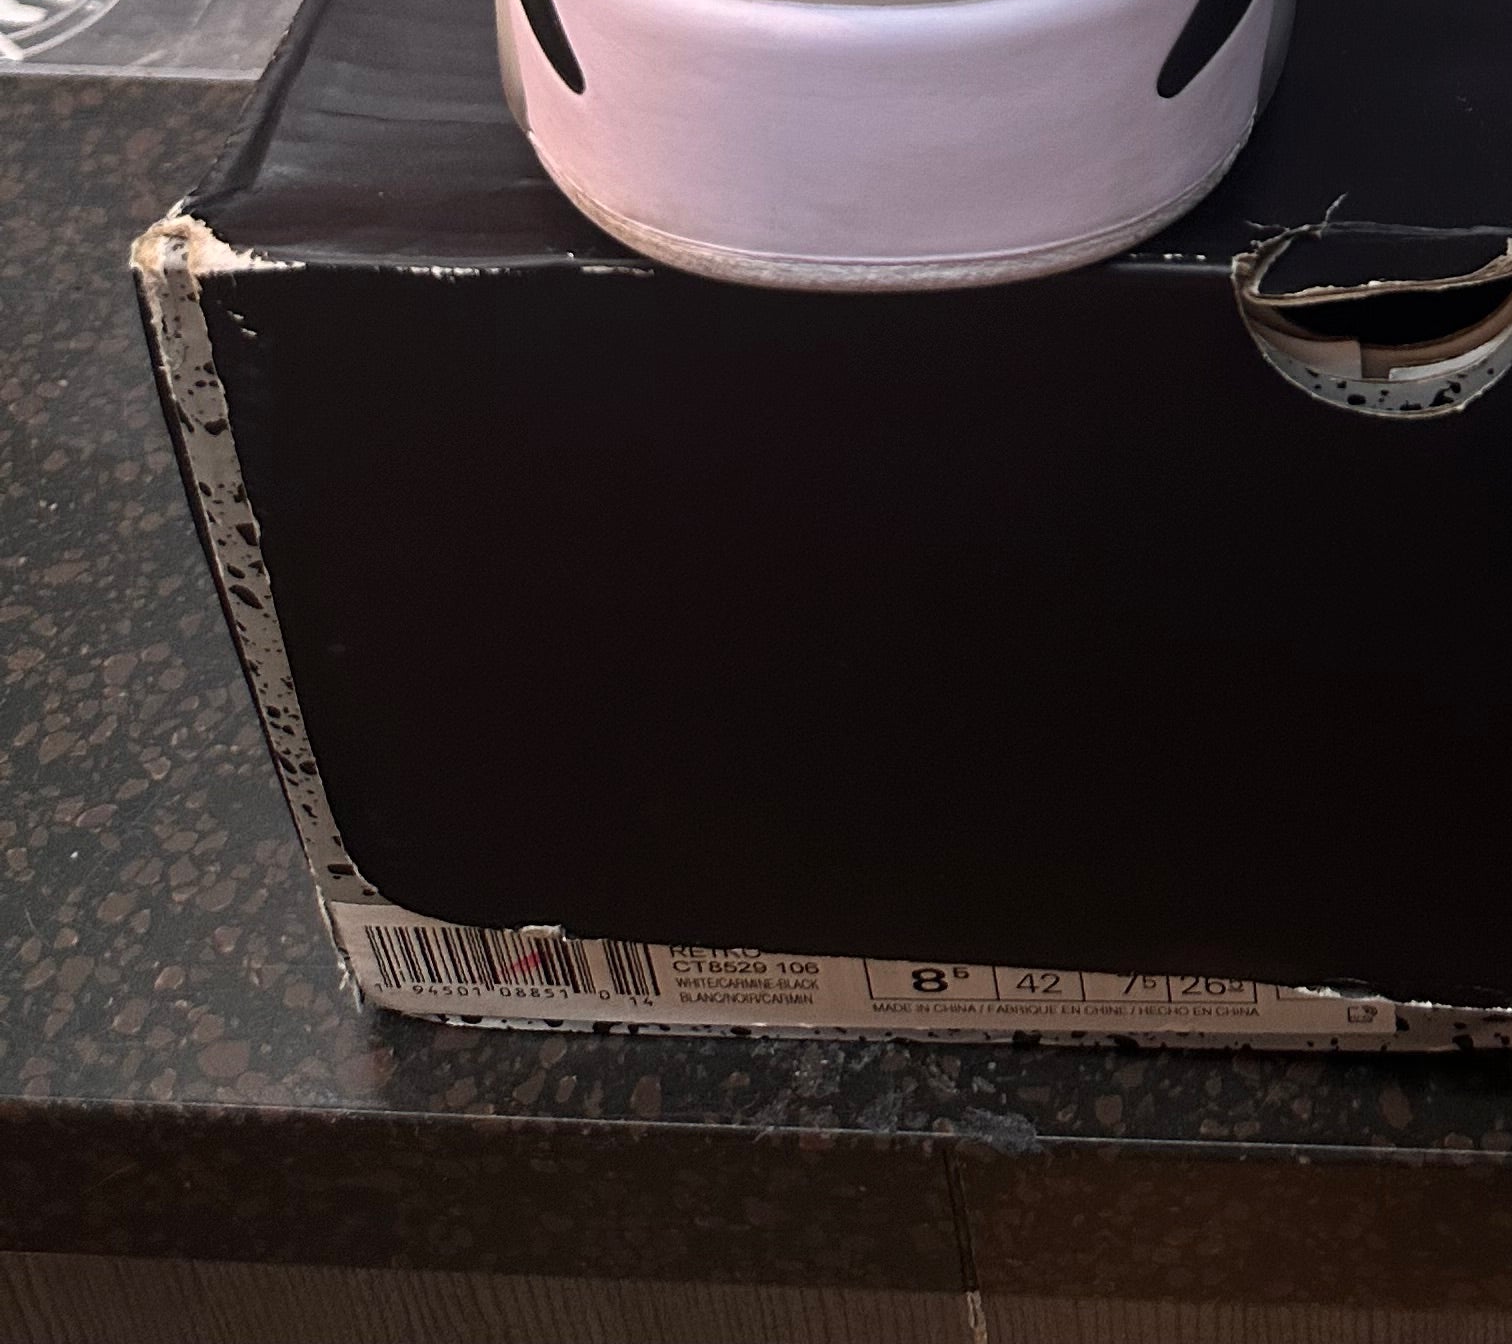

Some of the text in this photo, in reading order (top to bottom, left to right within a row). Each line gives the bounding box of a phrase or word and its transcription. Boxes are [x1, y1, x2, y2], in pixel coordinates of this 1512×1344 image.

[672, 960, 820, 975] CT8529 106
[412, 983, 482, 997] 94501
[500, 986, 569, 1000] 08851
[1016, 973, 1063, 995] 42
[872, 1003, 912, 1013] MADE
[933, 1003, 977, 1014] CHINA
